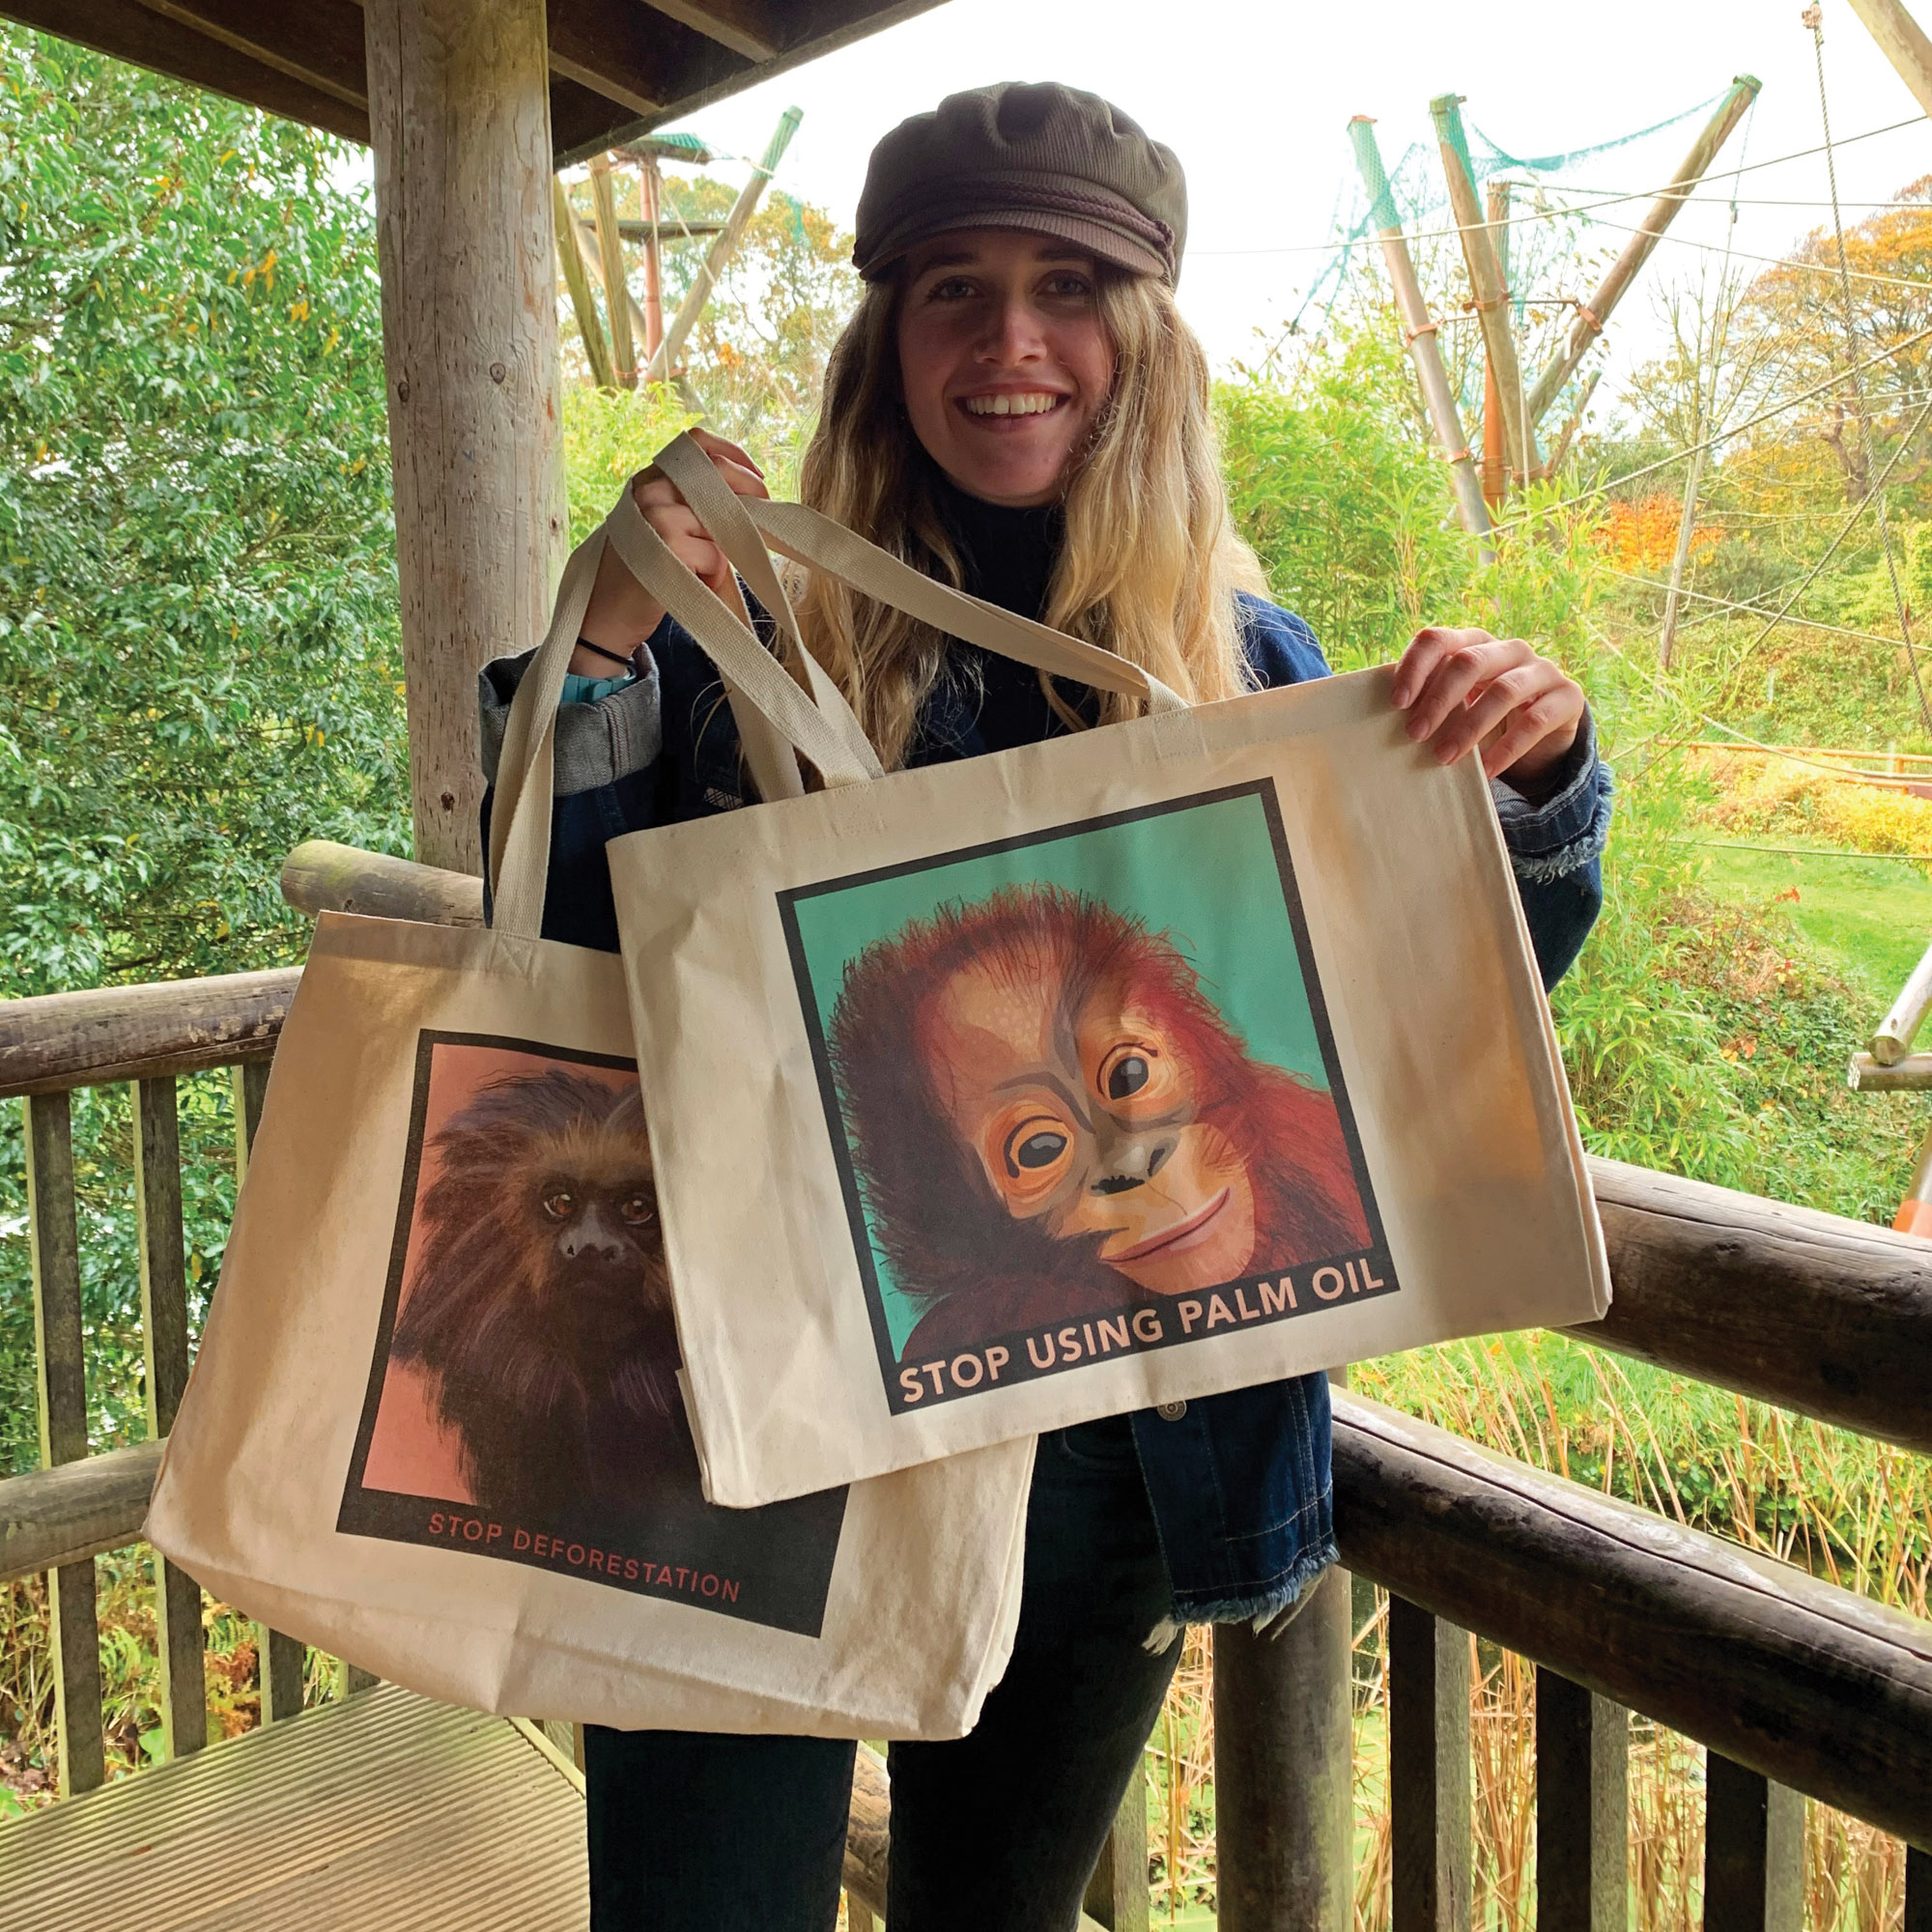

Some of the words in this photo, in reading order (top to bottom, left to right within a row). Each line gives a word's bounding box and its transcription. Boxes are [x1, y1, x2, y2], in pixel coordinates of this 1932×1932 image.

[899, 1347, 1010, 1404] STOP
[1026, 1309, 1164, 1370] USING
[1179, 1276, 1298, 1334] PALM
[1312, 1258, 1384, 1300] OIL
[429, 1513, 502, 1544] STOP
[514, 1529, 740, 1603] DEFORESTATION
